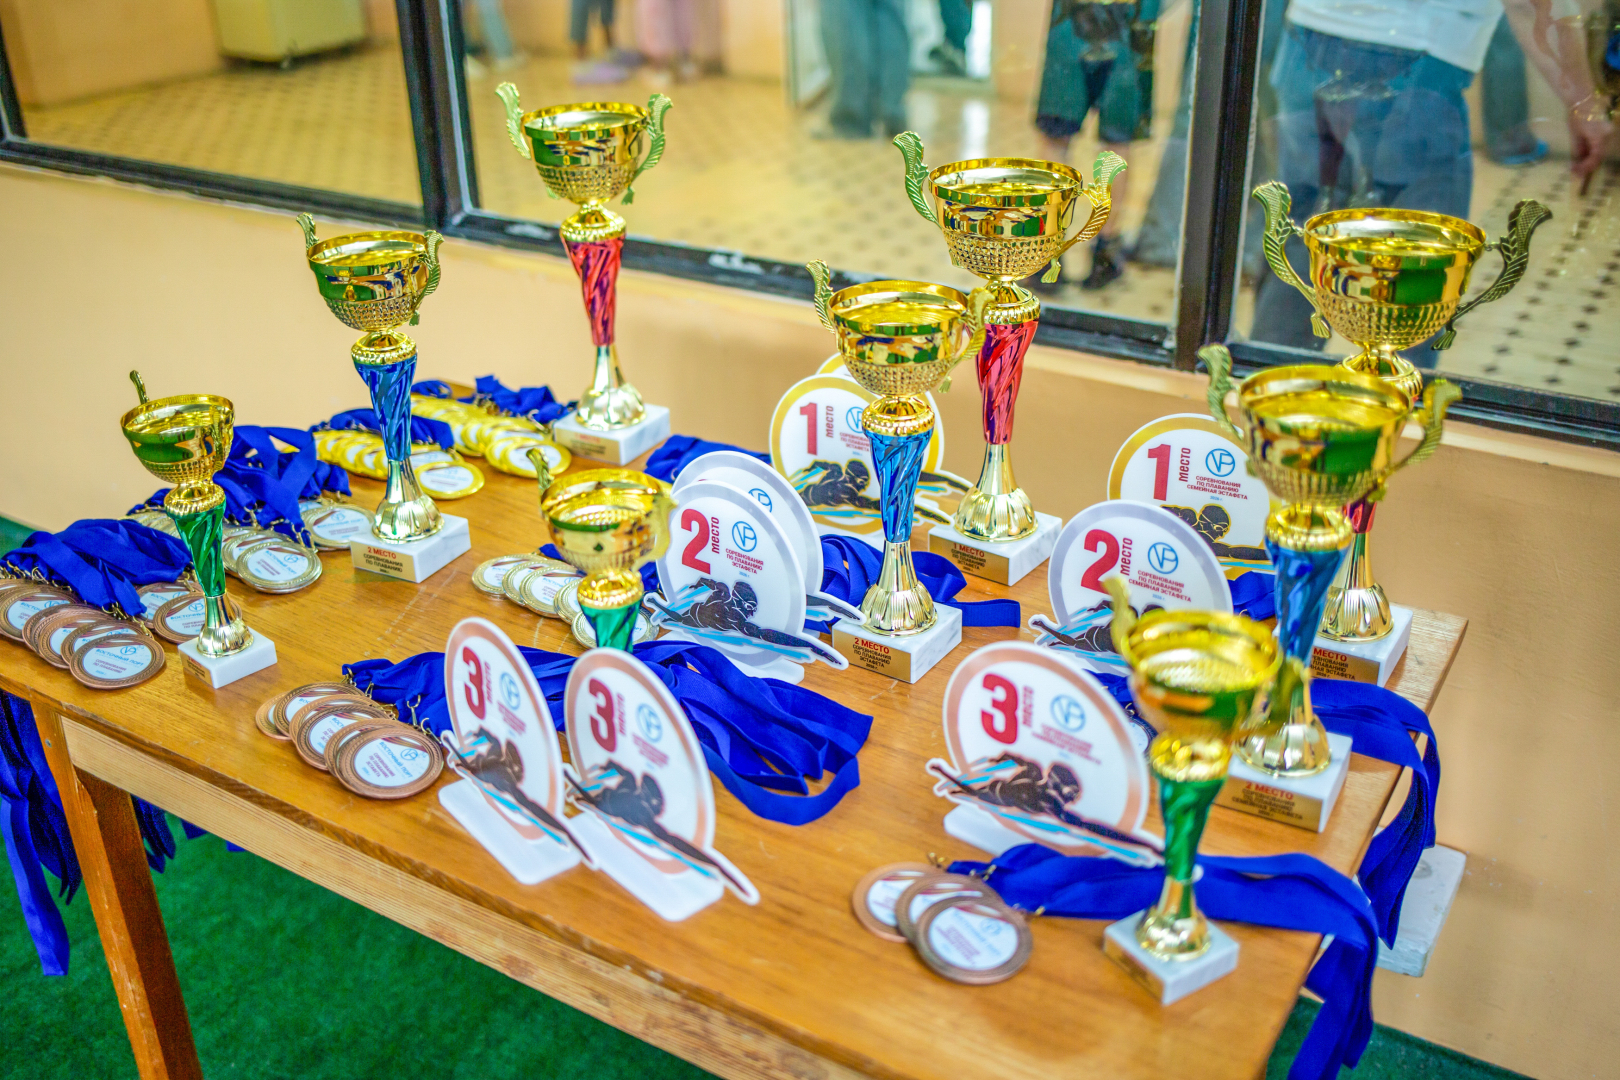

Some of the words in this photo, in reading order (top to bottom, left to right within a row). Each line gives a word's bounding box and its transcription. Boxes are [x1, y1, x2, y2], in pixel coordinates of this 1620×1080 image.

[800, 402, 818, 456] 1
[826, 406, 834, 438] место
[1147, 444, 1171, 502] 1
[1178, 448, 1191, 482] место
[1196, 476, 1241, 488] СОРЕВНОВАНИЯ
[1206, 482, 1239, 493] ПЛАВАНИЮ
[1186, 484, 1217, 494] СЕМЕЙНАЯ
[1218, 490, 1248, 500] ЭСТАФЕТА
[680, 508, 711, 575] 2
[710, 516, 720, 554] место
[373, 548, 396, 559] МЕСТО
[726, 548, 764, 566] СОРЕВНОВАНИЯ
[959, 544, 985, 558] МЕСТО
[1120, 537, 1133, 576] место
[363, 553, 403, 567] СОРЕВНОВАНИЯ
[374, 561, 403, 572] ПЛАВАНИЮ
[732, 561, 757, 574] ЭСТАФЕТА
[734, 556, 762, 571] ПЛАВАНИЮ
[1080, 528, 1120, 596] 2
[1138, 570, 1184, 588] СОРЕВНОВАНИЯ
[1138, 576, 1147, 584] ПО
[1147, 578, 1182, 593] ПЛАВАНИЮ
[1128, 578, 1160, 592] СЕМЕЙНАЯ
[1160, 588, 1191, 602] ЭСТАФЕТА
[853, 644, 891, 660] СОРЕВНОВАНИЯ
[861, 640, 889, 654] МЕСТО
[1314, 648, 1347, 662] МЕСТО
[860, 656, 884, 668] ЭСТАФЕТА
[862, 652, 890, 664] ПЛАВАНИЮ
[1326, 668, 1355, 680] ЭСТАФЕТА
[462, 646, 486, 720] 3
[588, 677, 617, 753] 3
[981, 672, 1018, 745] 3
[1246, 781, 1252, 789] 2
[1254, 783, 1294, 800] МЕСТО
